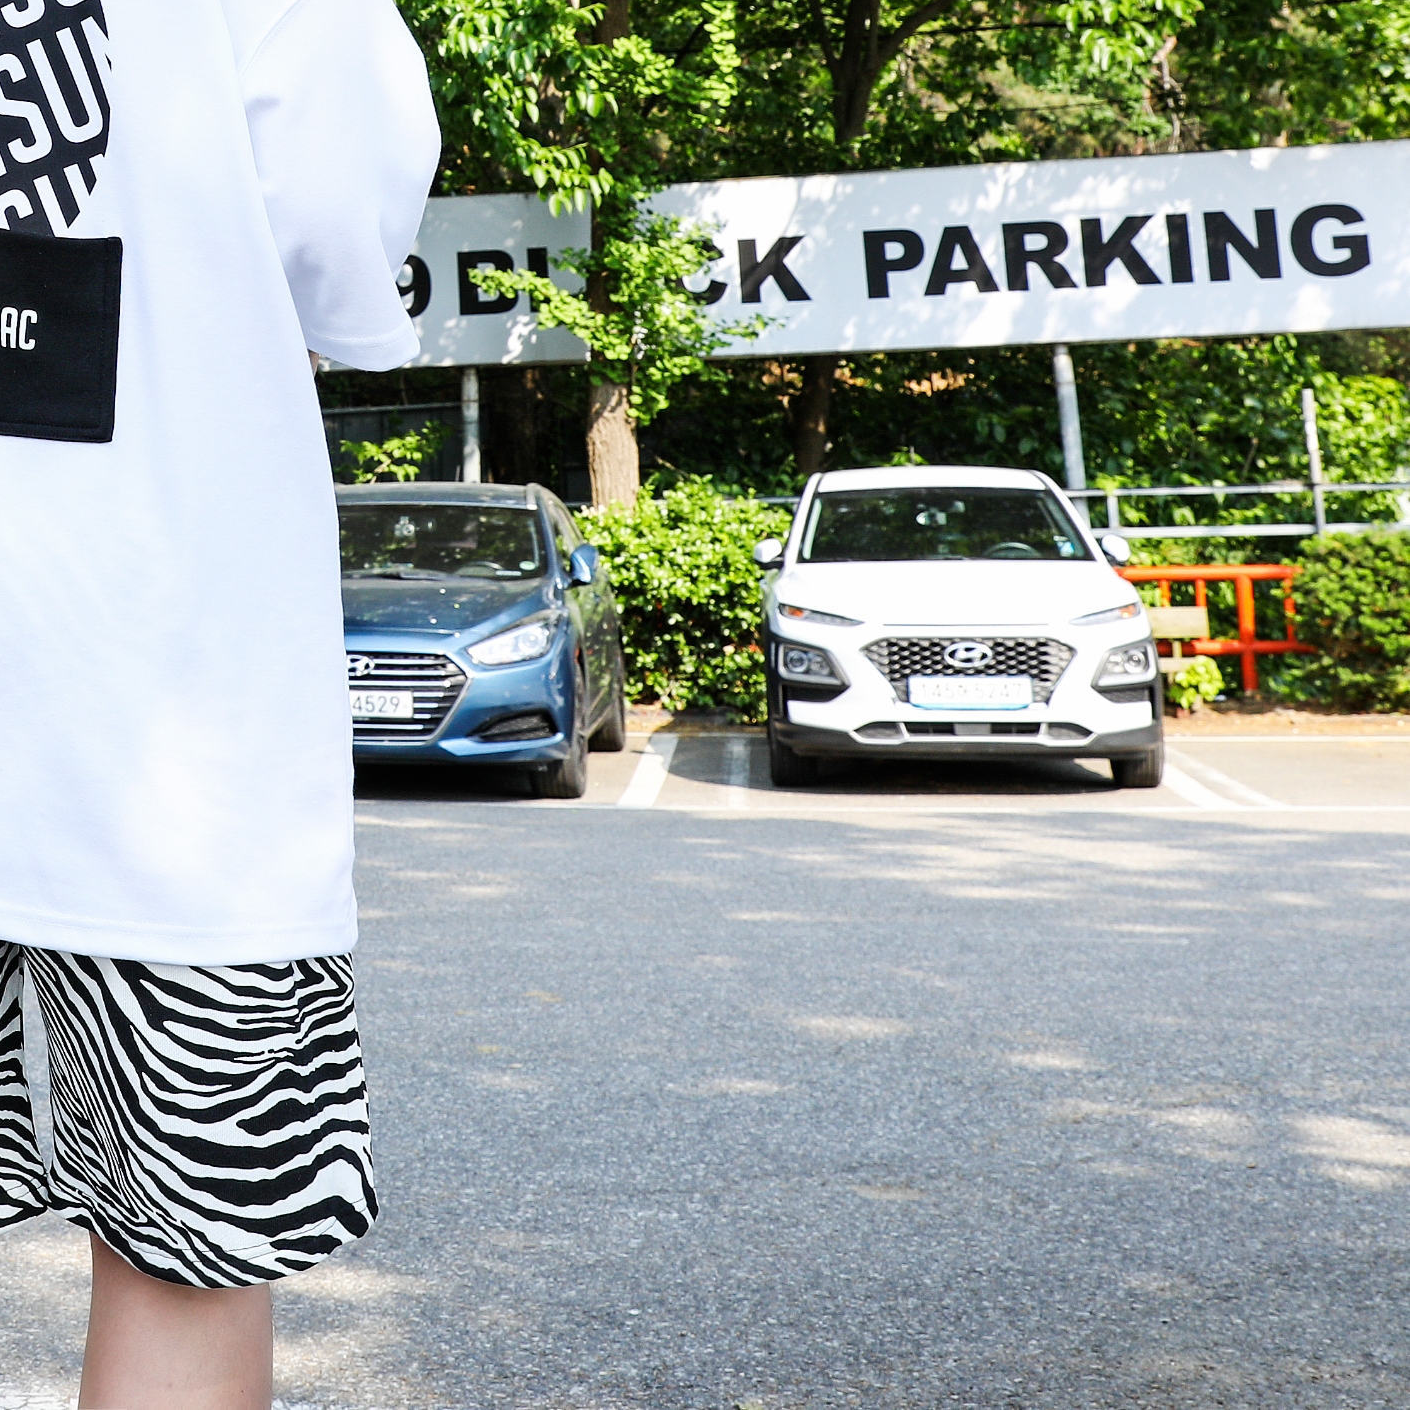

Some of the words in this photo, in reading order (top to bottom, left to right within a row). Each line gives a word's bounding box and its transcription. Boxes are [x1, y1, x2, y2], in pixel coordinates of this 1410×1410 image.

[456, 234, 813, 317] BLCK
[861, 203, 1372, 300] PARKING
[0, 305, 39, 351] AC
[351, 694, 401, 714] 4529
